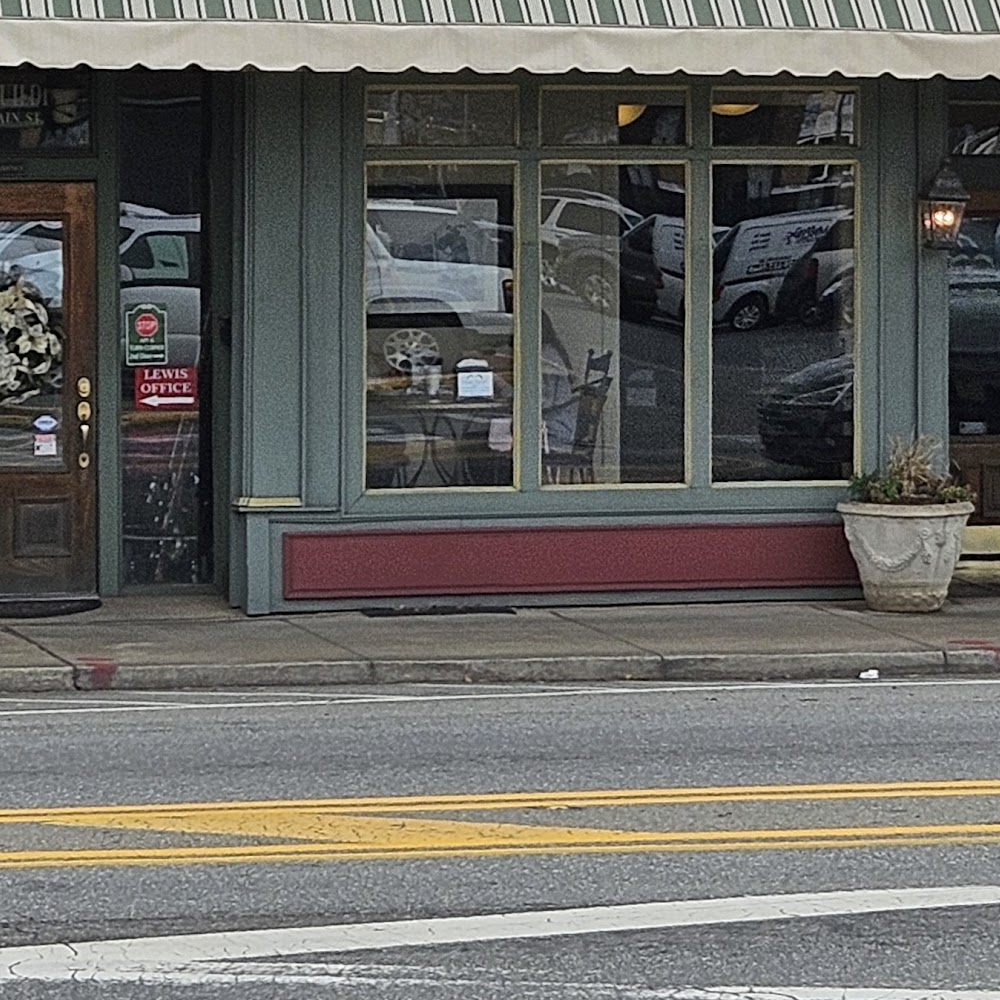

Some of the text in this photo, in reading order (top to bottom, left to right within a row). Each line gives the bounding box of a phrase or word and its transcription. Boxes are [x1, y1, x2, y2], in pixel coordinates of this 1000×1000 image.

[136, 320, 157, 330] STOP
[143, 368, 188, 380] LEWIS
[139, 382, 192, 394] OFFICE
